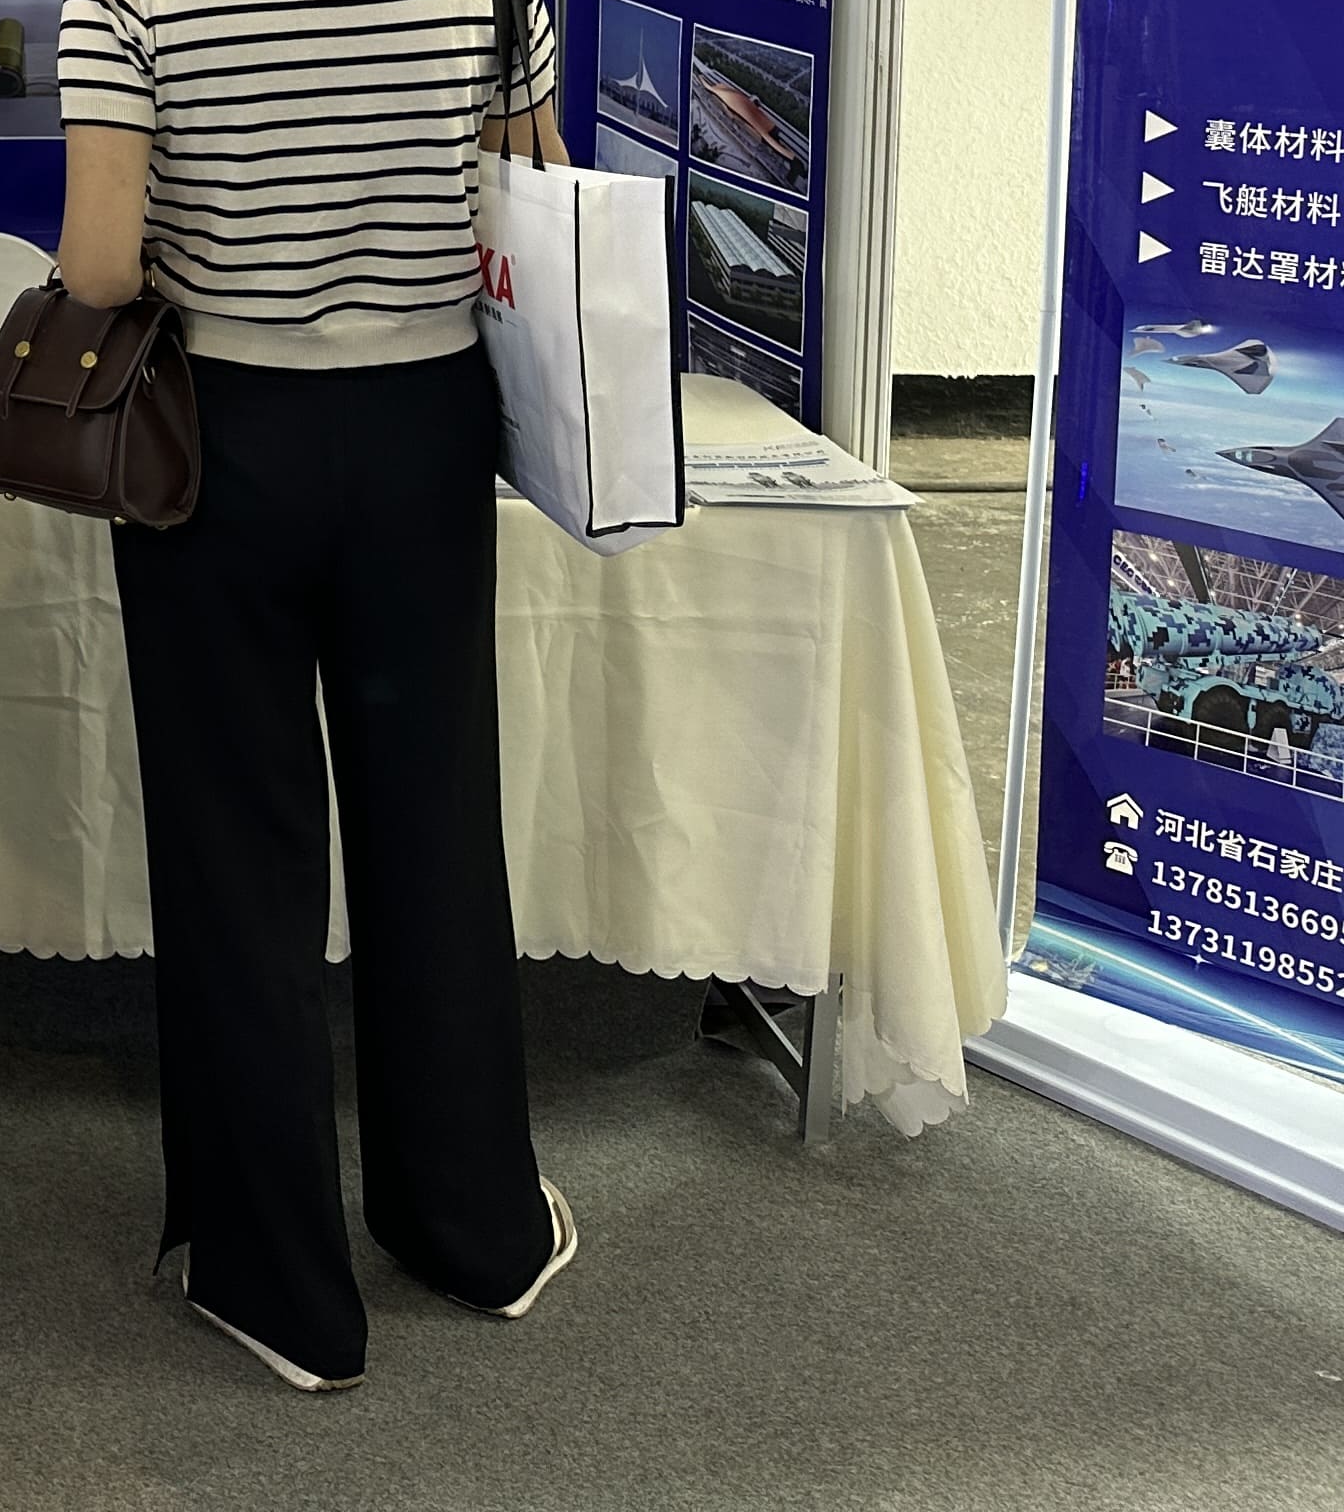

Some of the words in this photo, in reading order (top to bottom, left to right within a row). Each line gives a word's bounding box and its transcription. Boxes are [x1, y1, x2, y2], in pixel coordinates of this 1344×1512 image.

[1204, 119, 1344, 163] 囊体材料
[1202, 180, 1341, 227] 飞艇材料
[1199, 241, 1344, 290] 雷达罩材
[1155, 808, 1343, 894] 河北省石家庄
